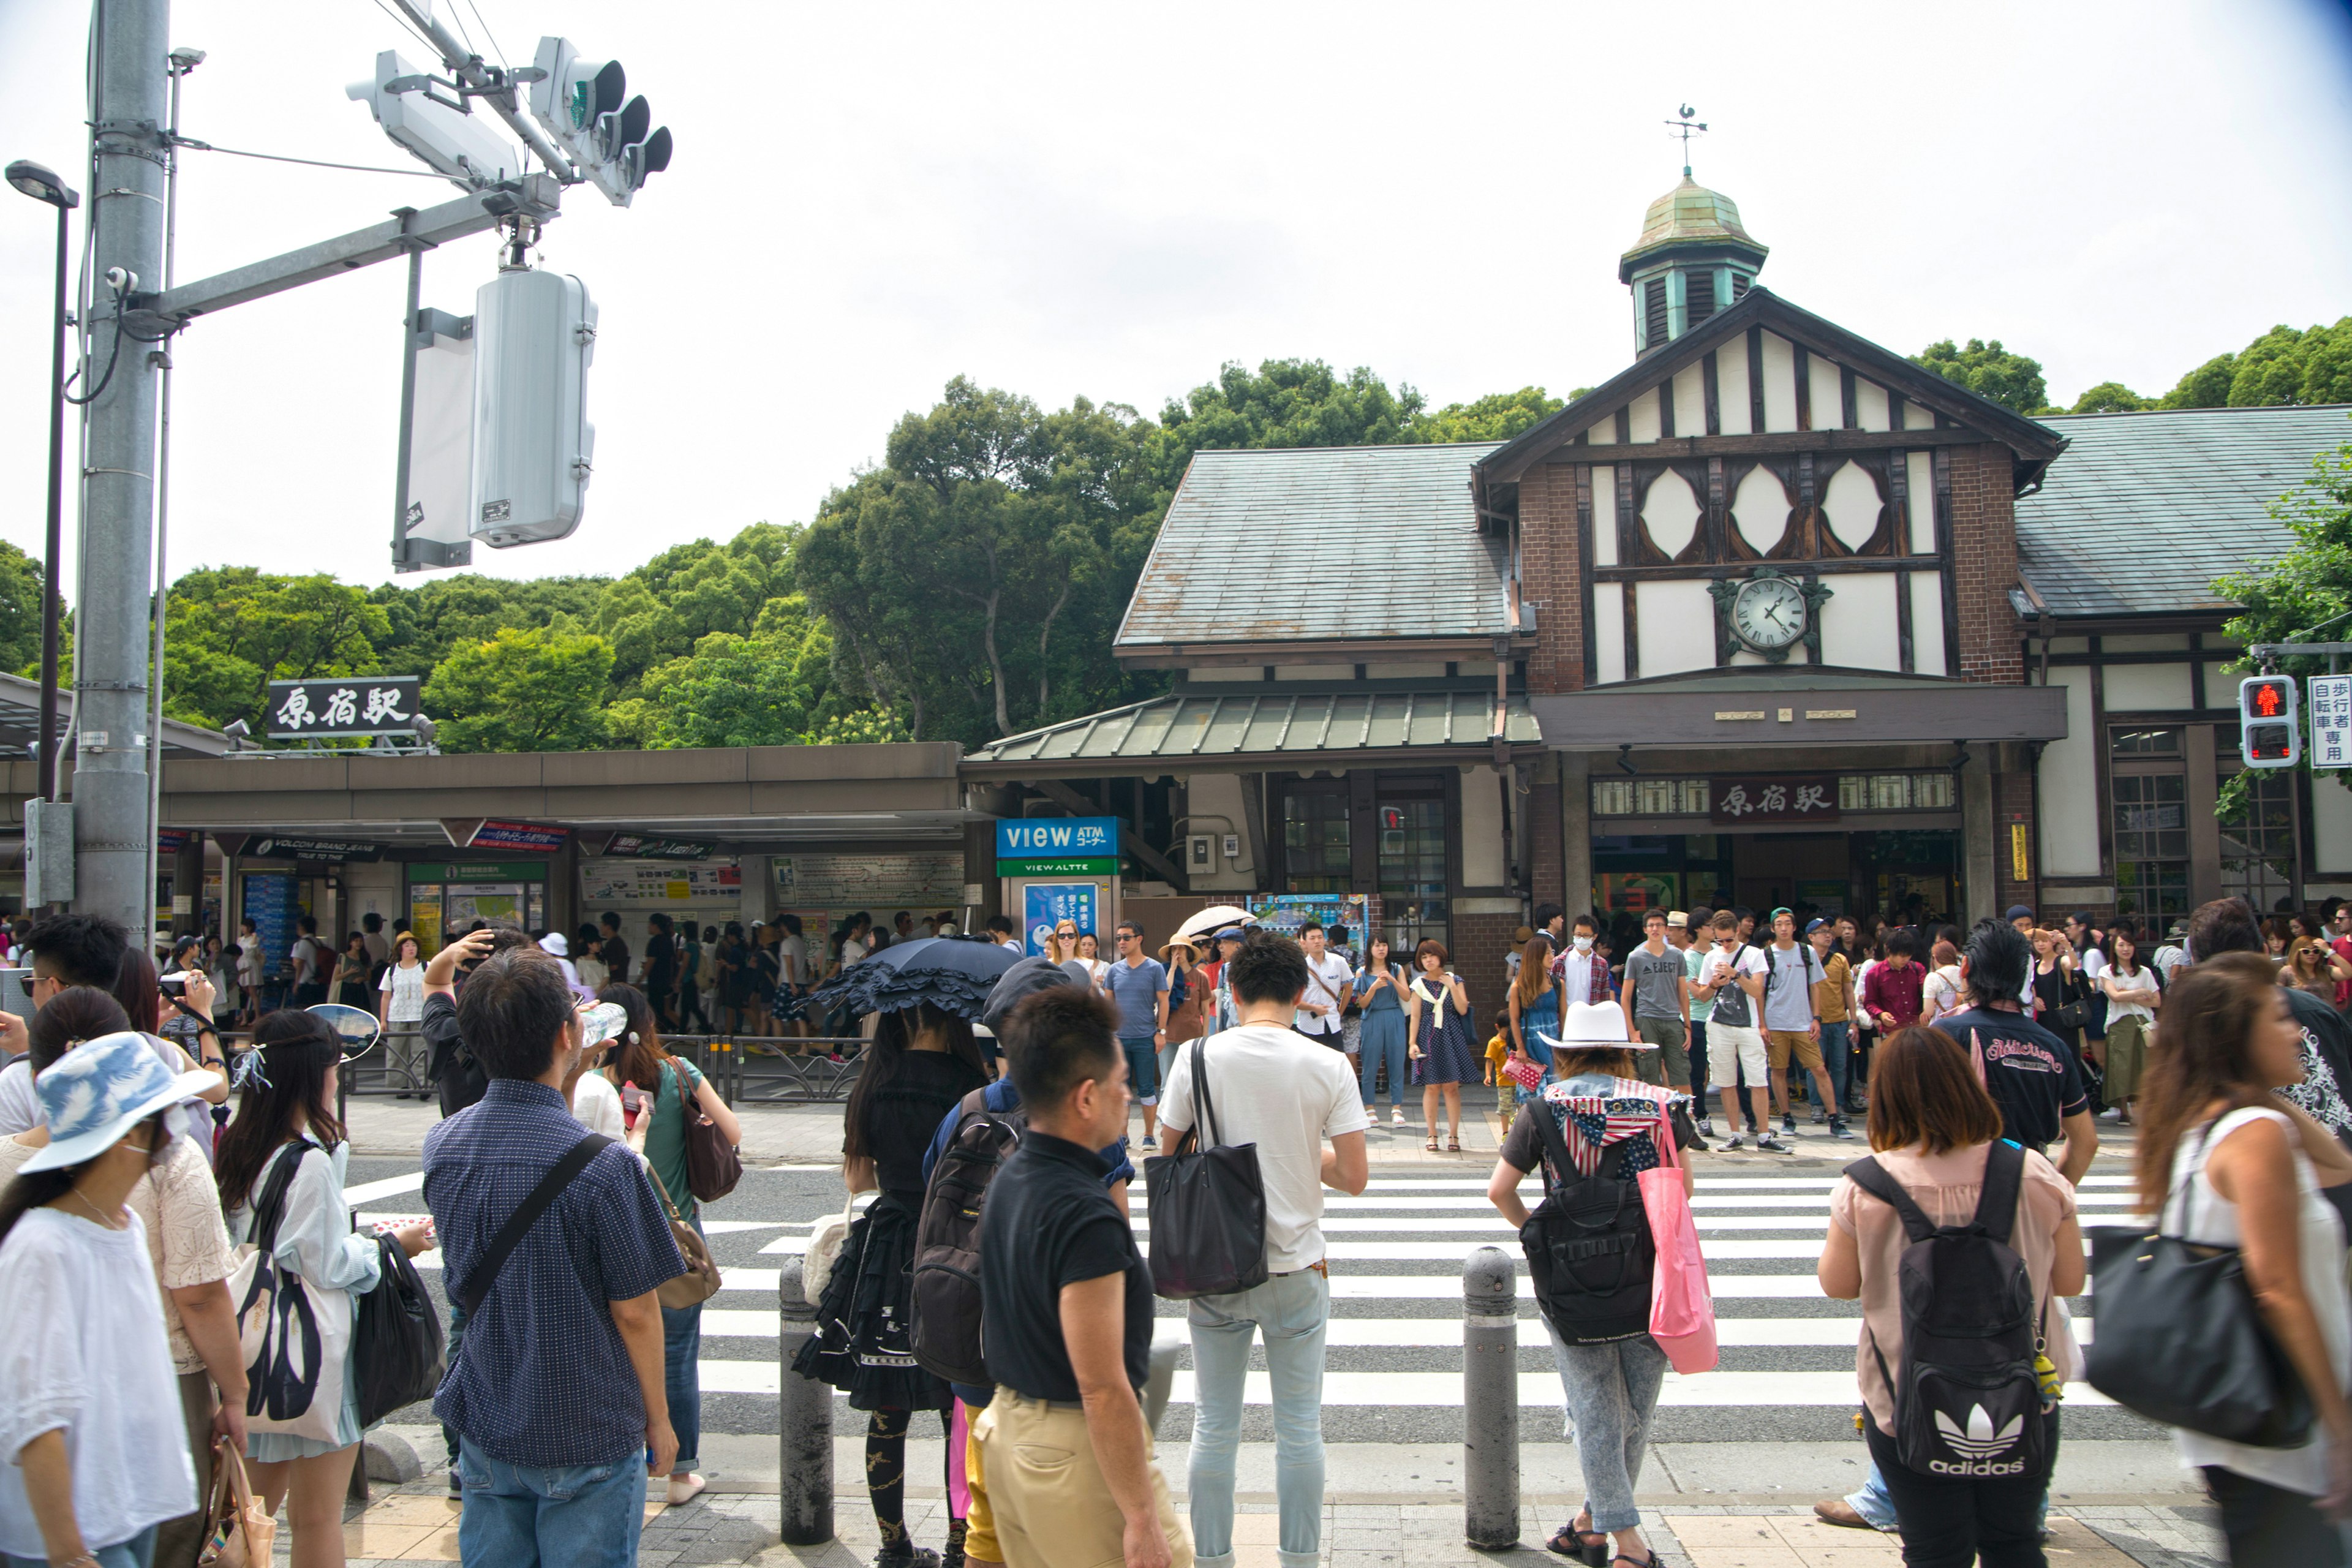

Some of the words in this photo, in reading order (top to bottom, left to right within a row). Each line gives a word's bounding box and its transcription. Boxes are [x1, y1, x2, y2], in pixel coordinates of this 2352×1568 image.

[276, 687, 410, 729] 原宿駅
[2315, 684, 2331, 729] 自転車
[2332, 683, 2349, 728] 歩行者
[2325, 731, 2342, 760] 専用
[1720, 785, 1832, 816] 原宿駅
[275, 839, 314, 848] VOLCOM
[315, 842, 346, 851] BRAND
[1077, 827, 1104, 837] ATM
[1077, 838, 1106, 846] コーナー
[1653, 962, 1676, 973] EJECT
[1986, 1038, 2063, 1074] Addiction
[1929, 1459, 2024, 1476] adidas
